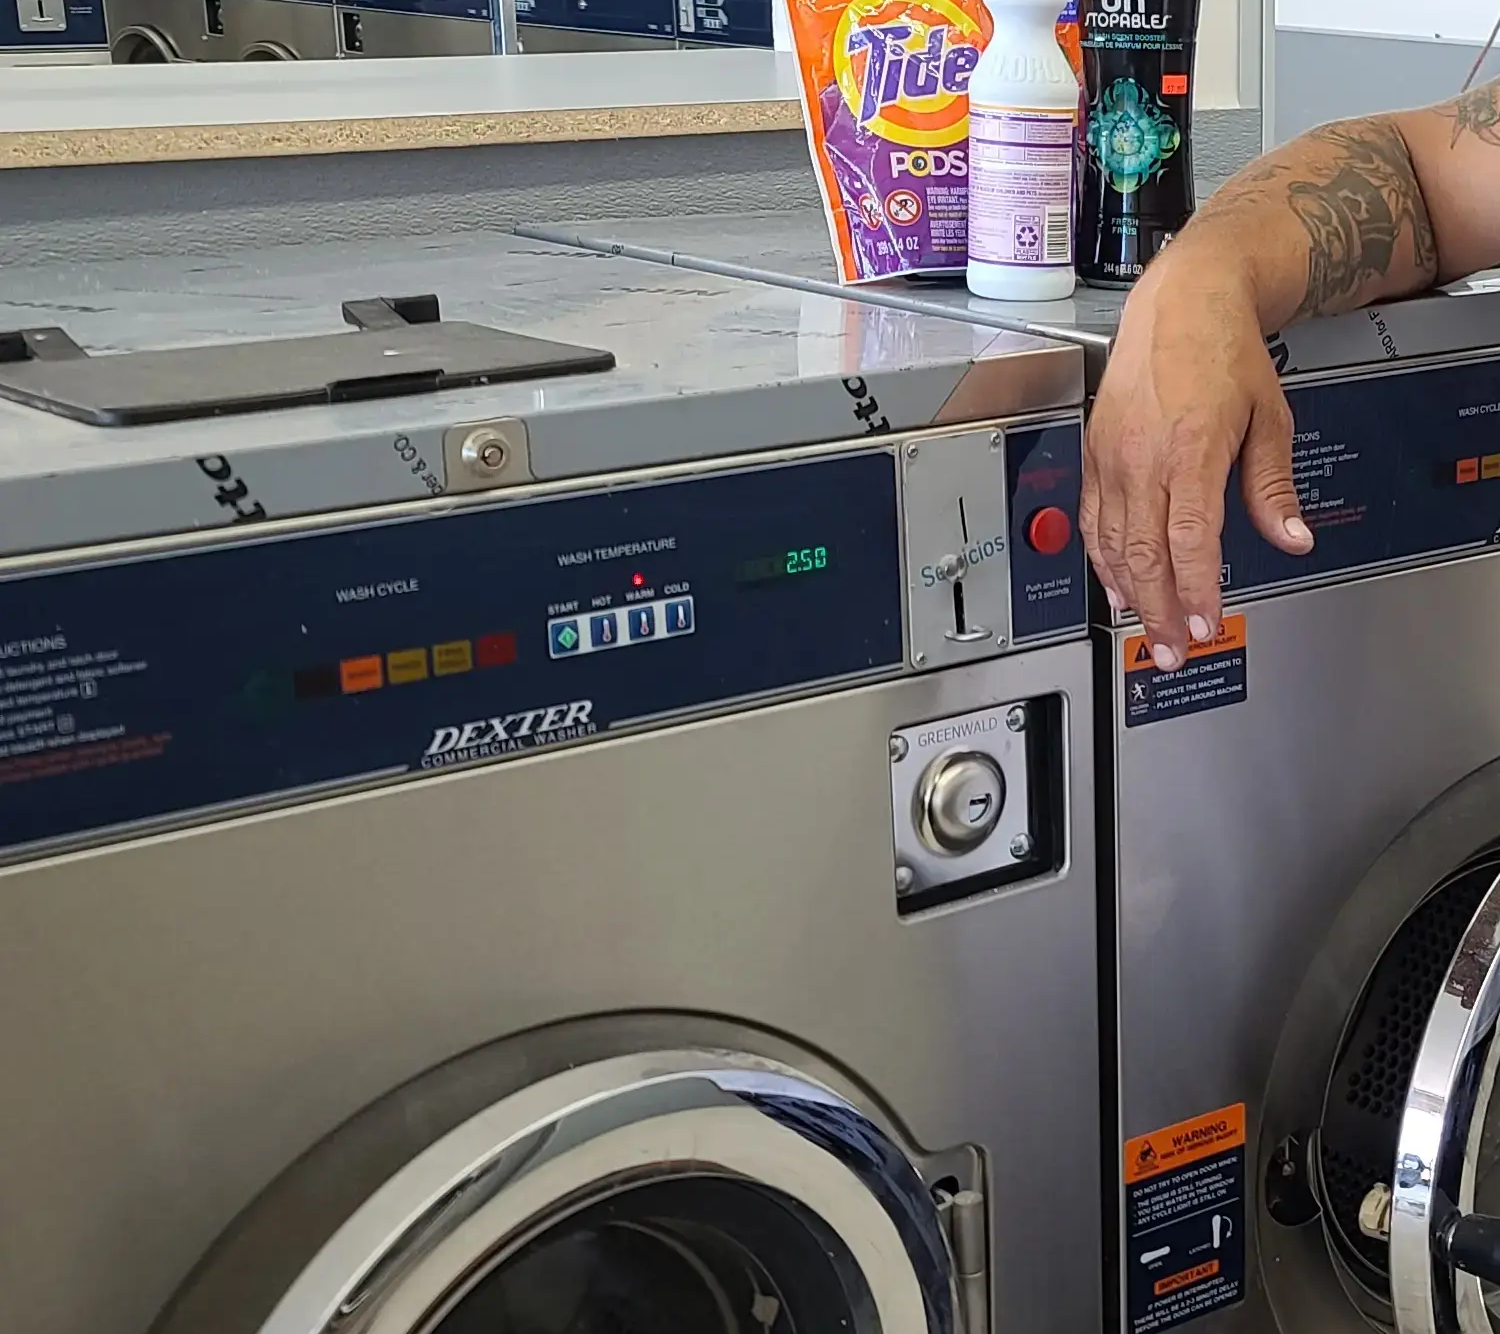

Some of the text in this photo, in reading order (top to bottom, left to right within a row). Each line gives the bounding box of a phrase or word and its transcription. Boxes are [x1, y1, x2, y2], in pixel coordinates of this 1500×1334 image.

[1085, 12, 1168, 29] STOPABLES
[1112, 33, 1165, 42] SCENT BOOSTER
[1115, 42, 1141, 50] PARFUM
[846, 23, 981, 123] Tide
[889, 150, 968, 178] PODS
[1111, 218, 1139, 226] FRESH
[905, 236, 920, 251] OZ
[1103, 262, 1115, 273] 244
[1375, 319, 1386, 336] for
[1458, 405, 1479, 418] WASH
[1309, 443, 1346, 455] and latch door
[1312, 452, 1359, 466] and fabric softener
[411, 457, 427, 475] &
[1304, 497, 1344, 511] when displayed
[557, 537, 677, 567] WASH TEMPERATURE
[786, 546, 828, 574] 2.50
[921, 535, 1005, 588] Seicios
[335, 577, 420, 603] WASH CYCLE
[1025, 575, 1071, 593] Push and Hold
[1027, 587, 1070, 602] for 3 seconds
[548, 581, 690, 616] START HOT WARM COLD
[1152, 673, 1175, 684] NEVER
[1176, 668, 1198, 679] ALLOW
[1199, 660, 1231, 673] CHILDREN
[1156, 676, 1225, 699] OPERATE THE MACHINE
[1156, 701, 1172, 710] PLAY
[1181, 696, 1190, 704] OR
[1191, 690, 1216, 702] AROUND
[1216, 683, 1243, 696] MACHINE
[424, 699, 593, 756] DEXTER
[918, 717, 998, 748] GREENWALD
[420, 722, 598, 769] COMMERCIAL WASHER
[1172, 1120, 1228, 1148] WARNING
[1132, 1189, 1143, 1198] DO
[1144, 1183, 1157, 1194] NOT
[1158, 1179, 1171, 1189] TRY
[1171, 1175, 1181, 1183] TO
[1181, 1169, 1199, 1181] OPEN
[1199, 1163, 1218, 1175] DOOR
[1137, 1198, 1150, 1208] THE
[1150, 1192, 1169, 1204] DRUM
[1177, 1184, 1194, 1194] STILL
[1195, 1173, 1222, 1187] TURNING
[1137, 1177, 1236, 1217] YOU SEE WATER IN THE WINDOW
[1137, 1216, 1151, 1225] ANY
[1151, 1208, 1172, 1220] CYCLE
[1199, 1192, 1217, 1203] STILL
[1217, 1188, 1227, 1197] ON
[1158, 1263, 1214, 1293] IMPORTANT
[1133, 1313, 1154, 1326] THERE
[1155, 1308, 1170, 1318] WILL
[1170, 1304, 1179, 1312] BE
[1195, 1288, 1218, 1302] MINUTE
[1218, 1280, 1239, 1293] DELAY
[1134, 1289, 1238, 1334] BEFORE THE DOOR CAN BE OPENED
[1154, 1294, 1176, 1308] POWER
